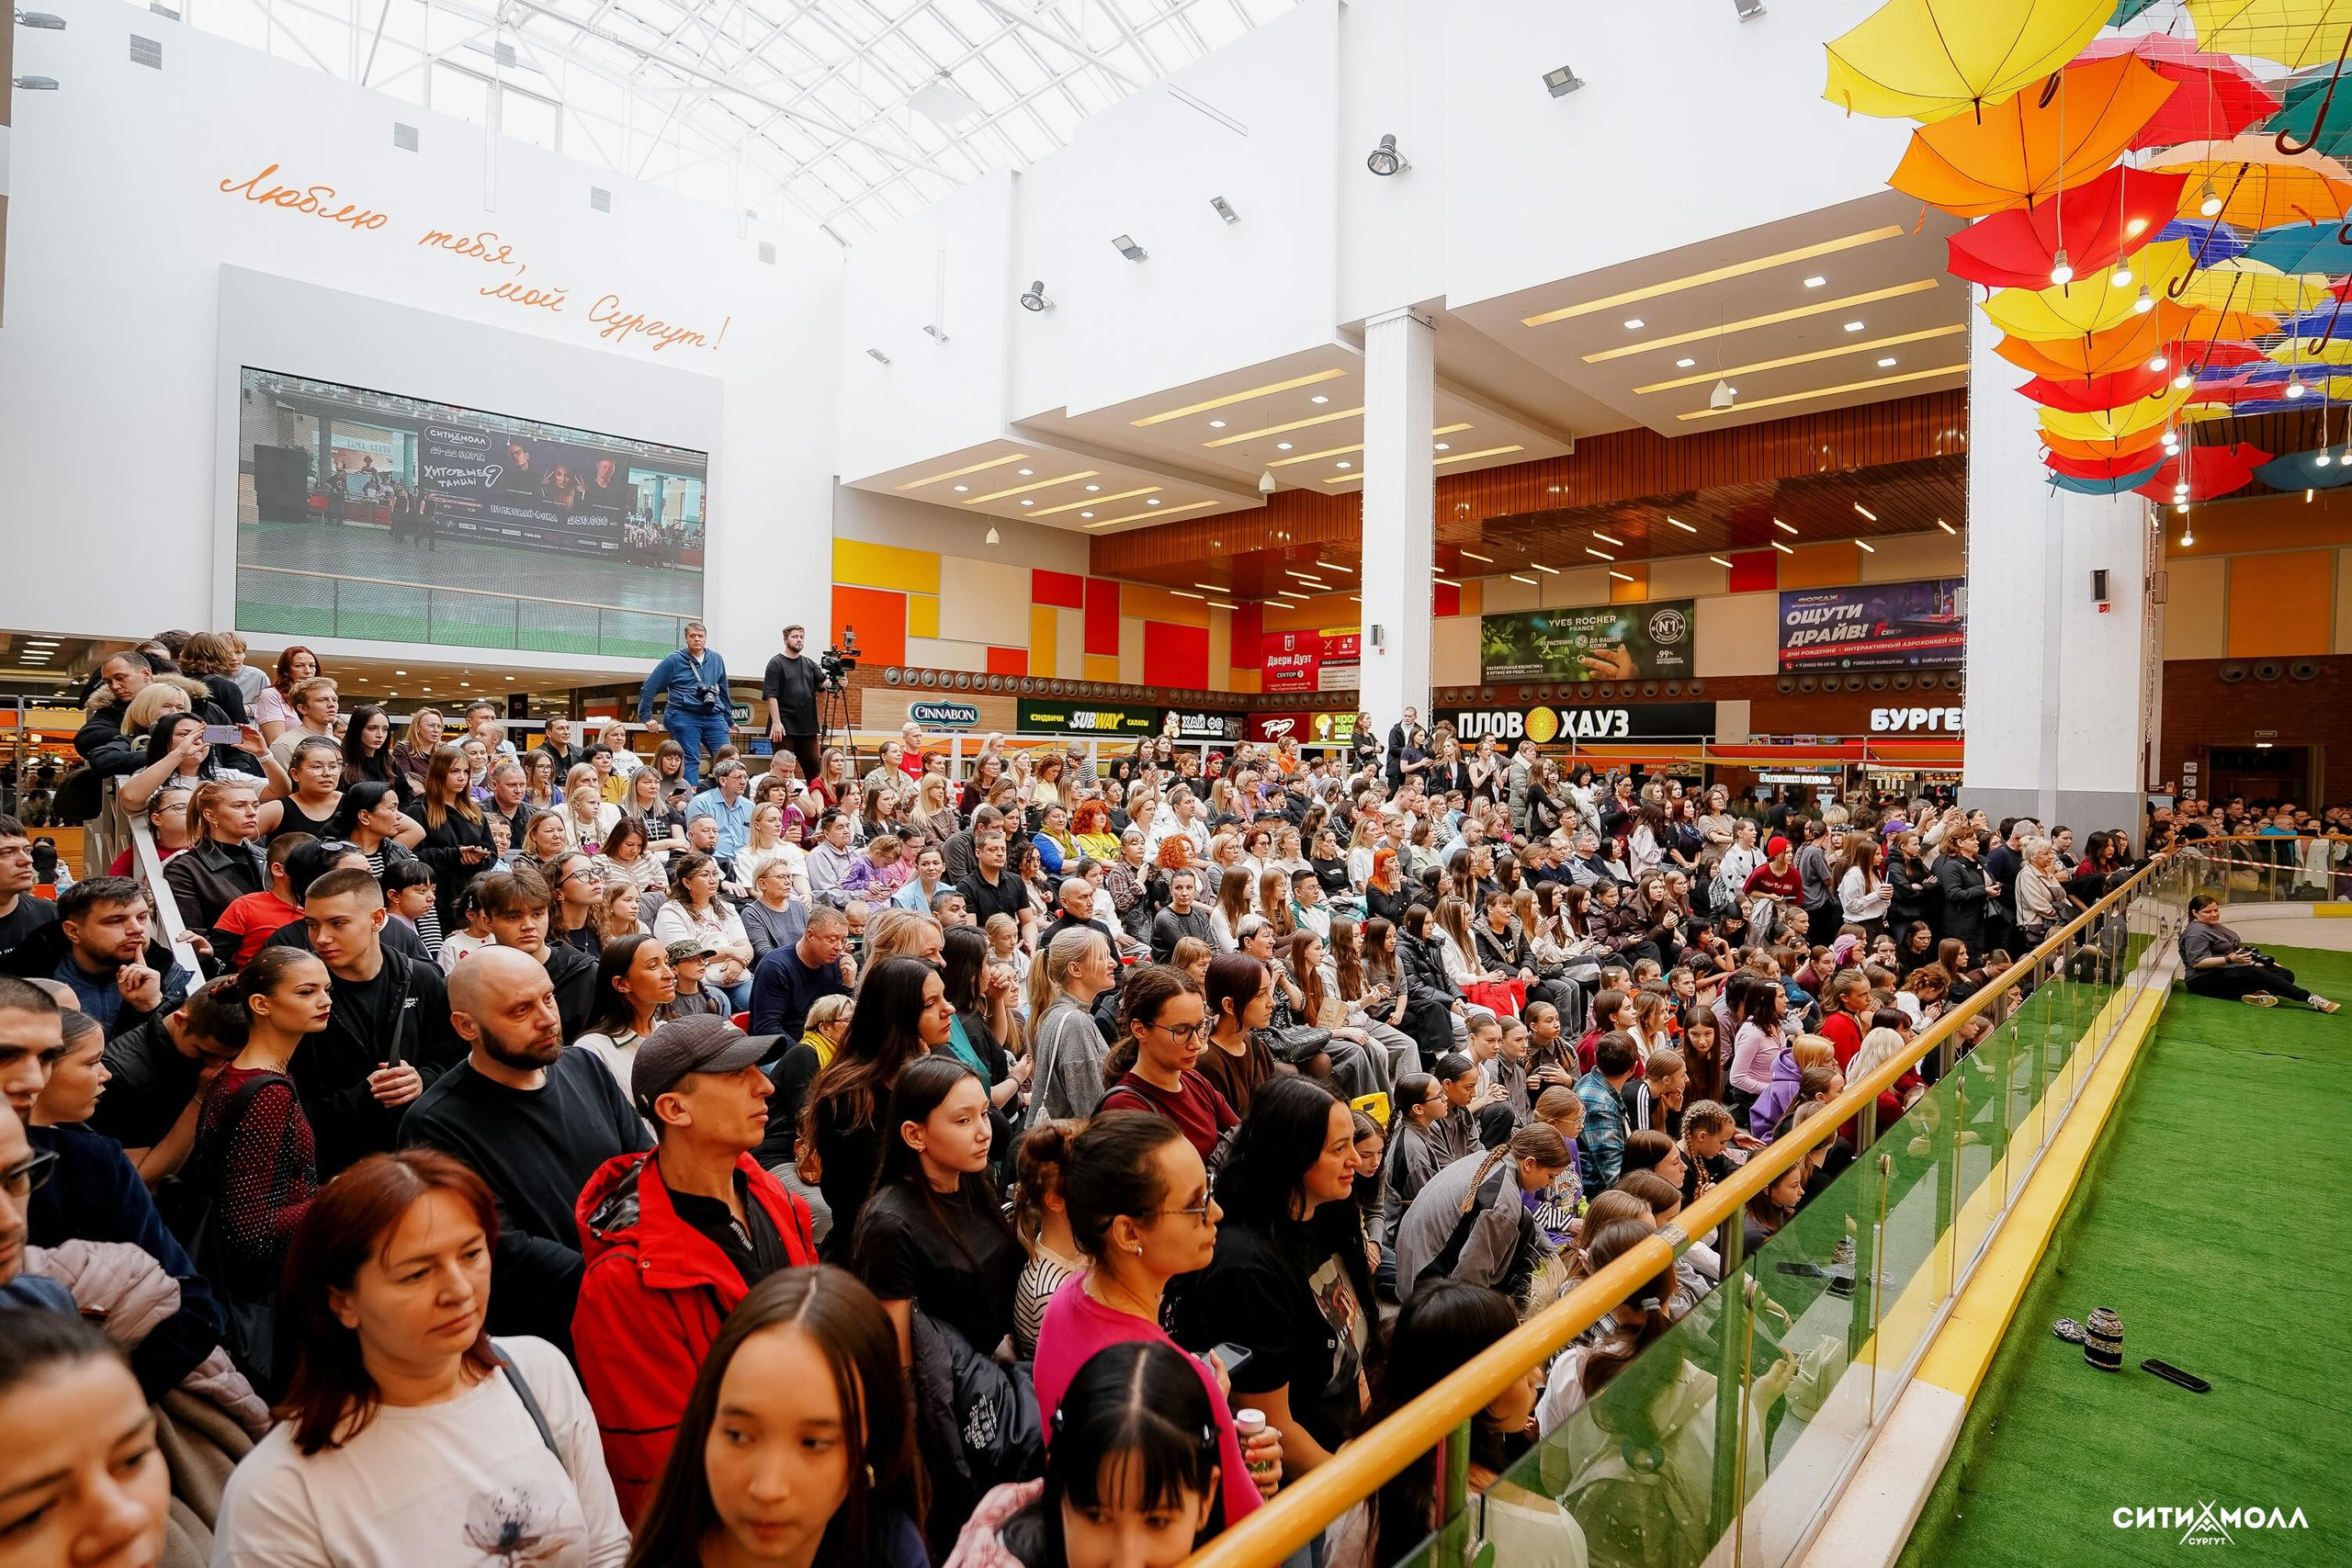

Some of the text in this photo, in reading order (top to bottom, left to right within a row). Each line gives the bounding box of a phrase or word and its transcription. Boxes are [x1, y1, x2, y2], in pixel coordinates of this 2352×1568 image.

[220, 164, 527, 276] Люблю тебя,
[480, 281, 731, 351] мой Сургут!
[424, 465, 484, 479] ХИТОВЫЕ
[437, 478, 477, 489] ТАНЦЫ
[1798, 594, 1838, 603] ФОРСАЖ
[1549, 615, 1617, 626] YVES ROCHER
[1786, 604, 1863, 626] ОЩУТИ
[1787, 622, 1869, 648] ДРАЙВ!
[1801, 648, 1836, 656] РОЖДЕНИЯ
[1844, 642, 1901, 653] ИНТЕРАКТИВНЫЙ
[1902, 637, 1947, 648] АЭРОХОККЕЙ
[1268, 653, 1312, 667] Двери Дуэт
[915, 706, 975, 720] CINNABON
[1030, 714, 1065, 723] СЭНДВИЧИ
[1067, 711, 1125, 729] SUBWAY
[1871, 707, 1963, 731] БУРГЕ
[1126, 718, 1148, 727] САЛАТЫ
[1182, 714, 1223, 729] ХАЙ ФО
[1458, 709, 1629, 738] ПЛОВ ХАУЗ
